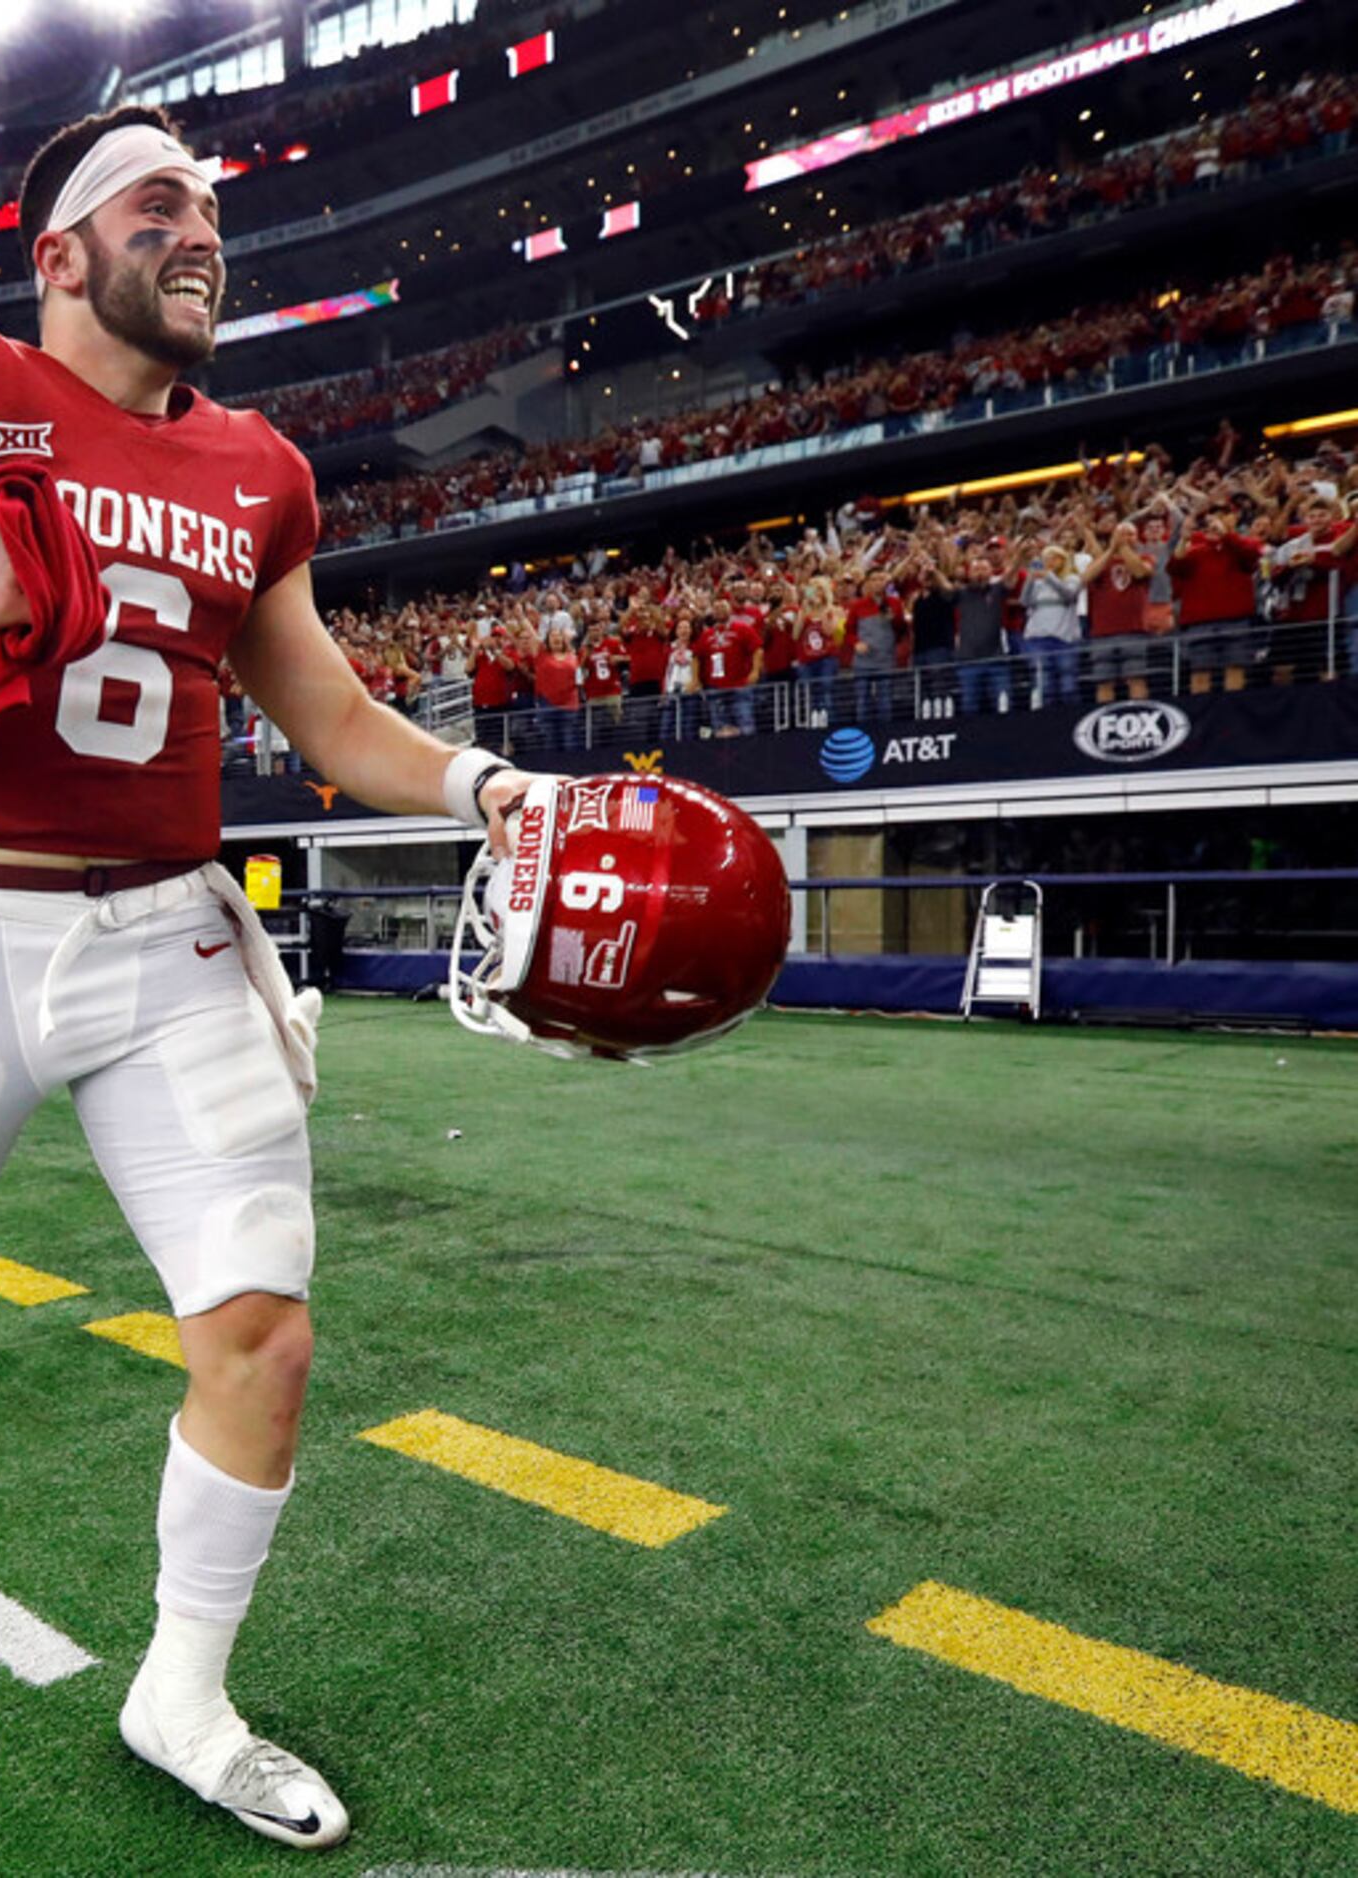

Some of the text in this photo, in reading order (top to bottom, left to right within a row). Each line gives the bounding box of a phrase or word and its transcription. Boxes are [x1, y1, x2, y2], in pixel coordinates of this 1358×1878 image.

[1013, 33, 1145, 98] FOOTBALL
[55, 562, 193, 765] 6
[710, 652, 725, 678] 1
[1099, 710, 1162, 738] FOX
[883, 733, 957, 765] AT&T
[509, 805, 545, 912] SOONERS
